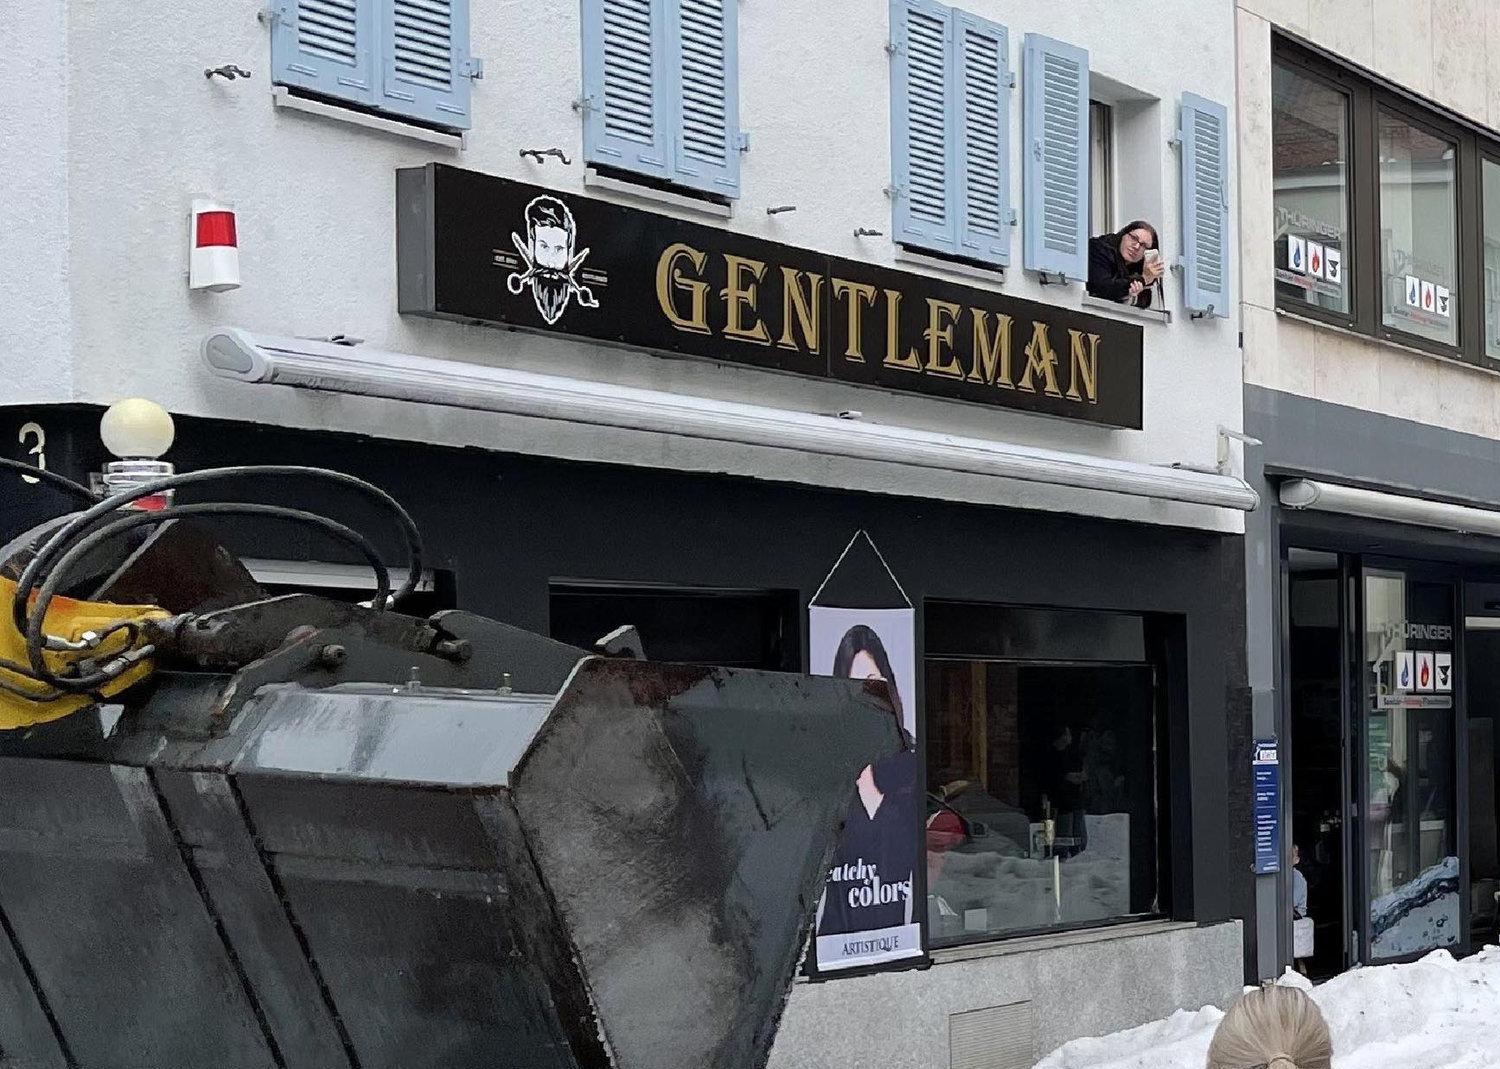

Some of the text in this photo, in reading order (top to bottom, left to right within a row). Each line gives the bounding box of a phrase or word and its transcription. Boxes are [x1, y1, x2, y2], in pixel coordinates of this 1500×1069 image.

[655, 243, 1101, 404] GENTLEMAN
[848, 875, 910, 908] colors
[842, 936, 899, 955] ARTISTIQUE
